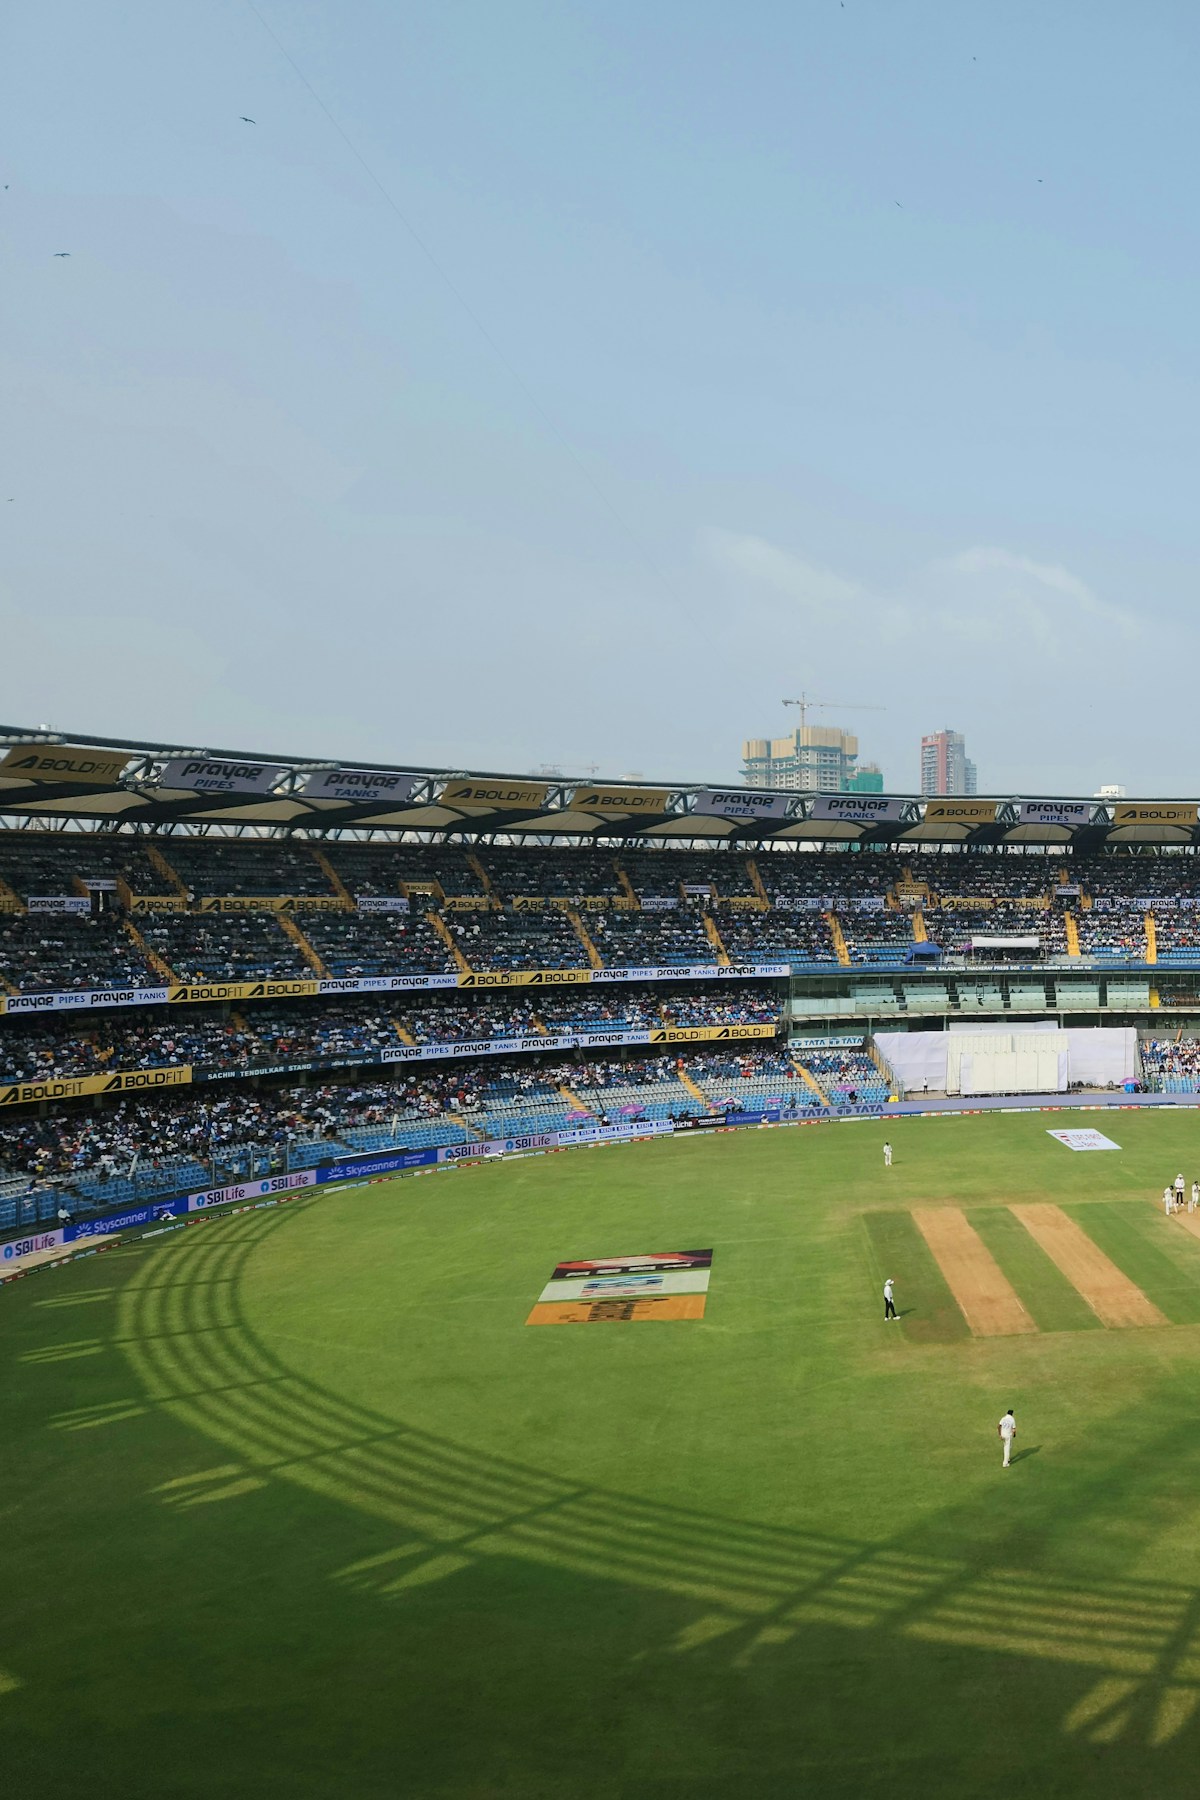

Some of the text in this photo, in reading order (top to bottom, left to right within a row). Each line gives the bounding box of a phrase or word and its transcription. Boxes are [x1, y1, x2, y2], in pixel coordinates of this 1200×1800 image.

[39, 758, 122, 775] BOLDFIT
[181, 762, 264, 780] prayag
[193, 778, 236, 789] PIPES
[324, 770, 401, 789] prayag
[334, 788, 380, 798] TANKS
[473, 790, 541, 802] BOLDFIT
[600, 796, 663, 807] BOLDFIT
[711, 794, 774, 808] prayag
[828, 799, 889, 812] prayag
[724, 806, 756, 815] PIPES
[837, 811, 876, 819] TANKS
[946, 808, 994, 816] BOLDFIT
[1026, 803, 1084, 815] prayag
[1140, 810, 1193, 819] BOLDFIT
[1040, 814, 1069, 822] PIPES
[319, 979, 359, 991] prayag
[363, 979, 387, 987] PIPES
[391, 976, 429, 989] prayag
[59, 992, 166, 1005] PIPES prayag TANKS
[383, 1047, 422, 1060] prayag
[426, 1046, 449, 1055] PIPES
[453, 1042, 491, 1055] prayag
[494, 1042, 518, 1050] TANKS
[521, 1037, 558, 1050] prayag
[208, 1063, 312, 1080] SACHIN TENDULKAR STAND
[800, 1105, 830, 1117] TATA
[854, 1103, 885, 1115] TATA
[516, 1136, 532, 1150] SBI
[533, 1134, 550, 1148] Life
[472, 1142, 491, 1156] Life
[346, 1158, 399, 1177] Skyscanner
[271, 1174, 308, 1191] SBI Life
[207, 1187, 245, 1205] SBI Life
[94, 1210, 147, 1233] Skyscanner
[15, 1234, 55, 1256] SBI Life
